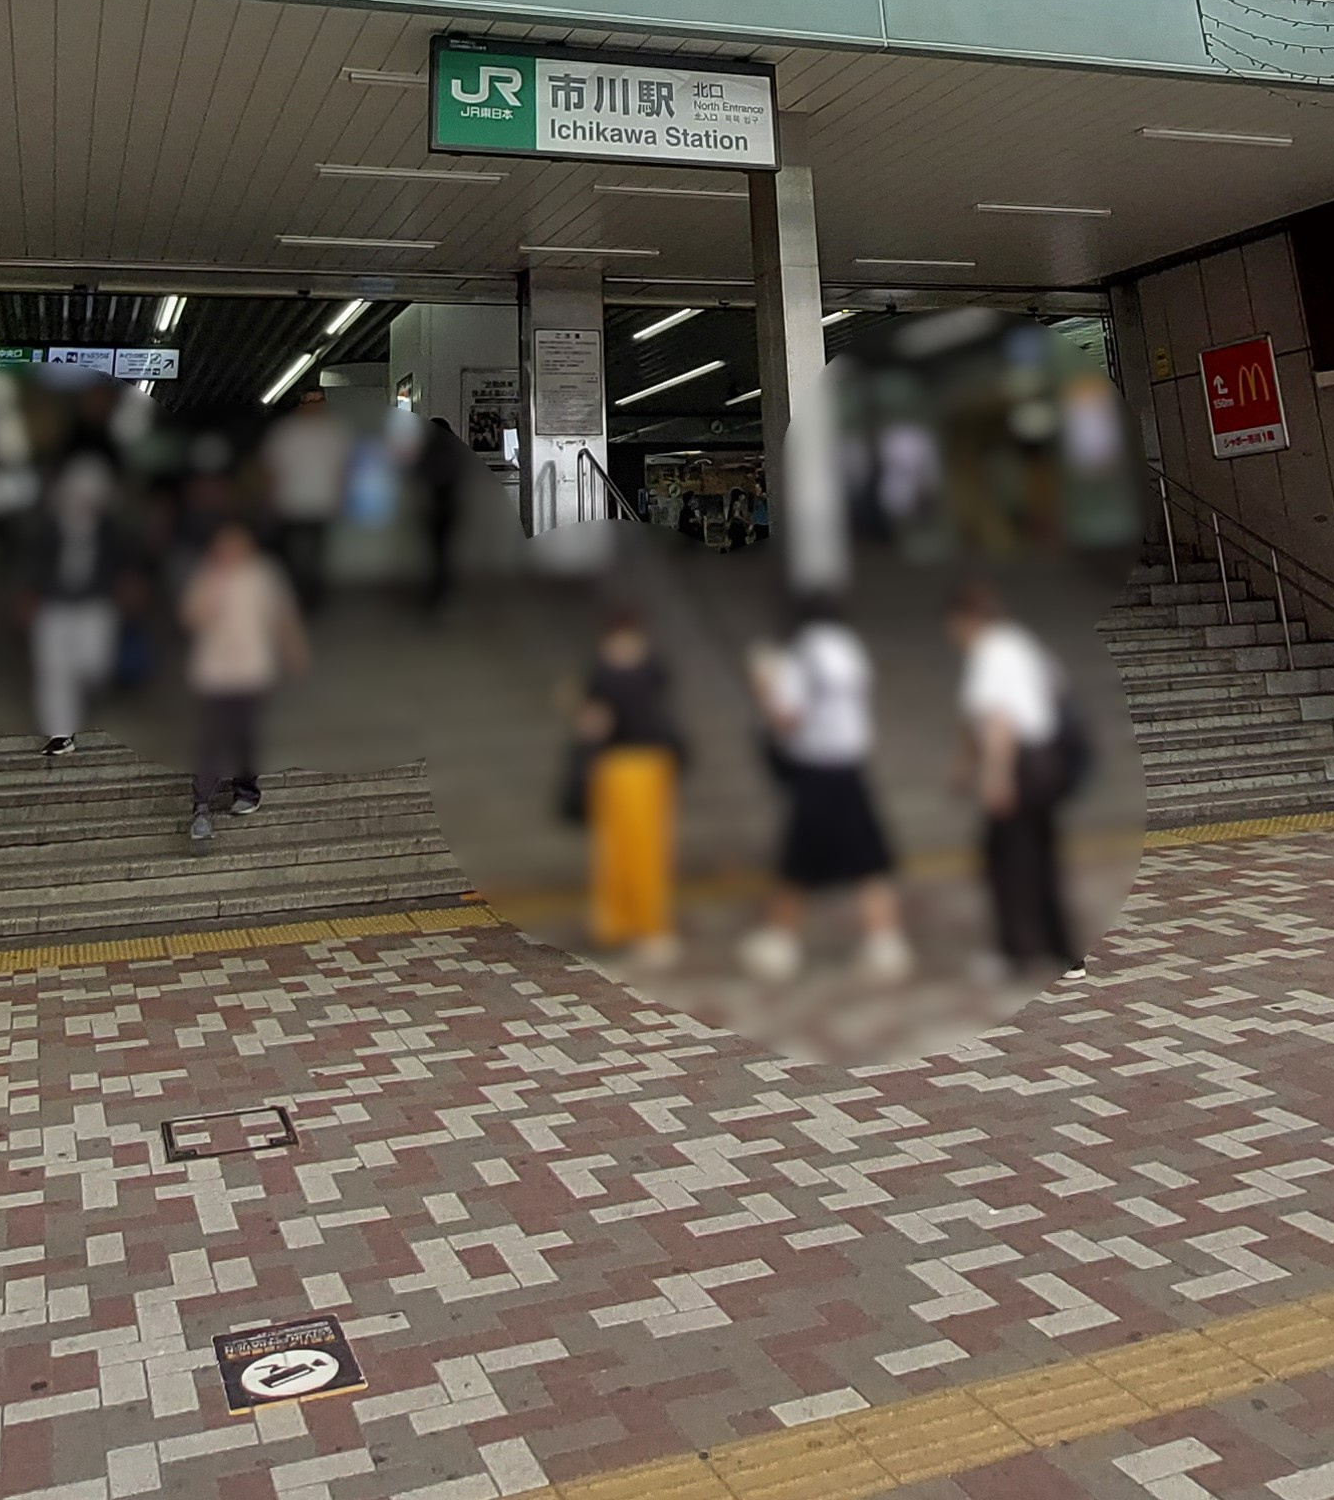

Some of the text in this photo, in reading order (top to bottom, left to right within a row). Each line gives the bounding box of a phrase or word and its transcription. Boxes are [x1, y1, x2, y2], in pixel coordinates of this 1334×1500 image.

[451, 65, 523, 107] JR
[547, 73, 676, 119] 市川駅
[692, 81, 724, 99] 北口
[460, 106, 514, 121] JR東日本
[693, 100, 765, 114] North Entrance
[549, 118, 749, 152] Ichikawa Station
